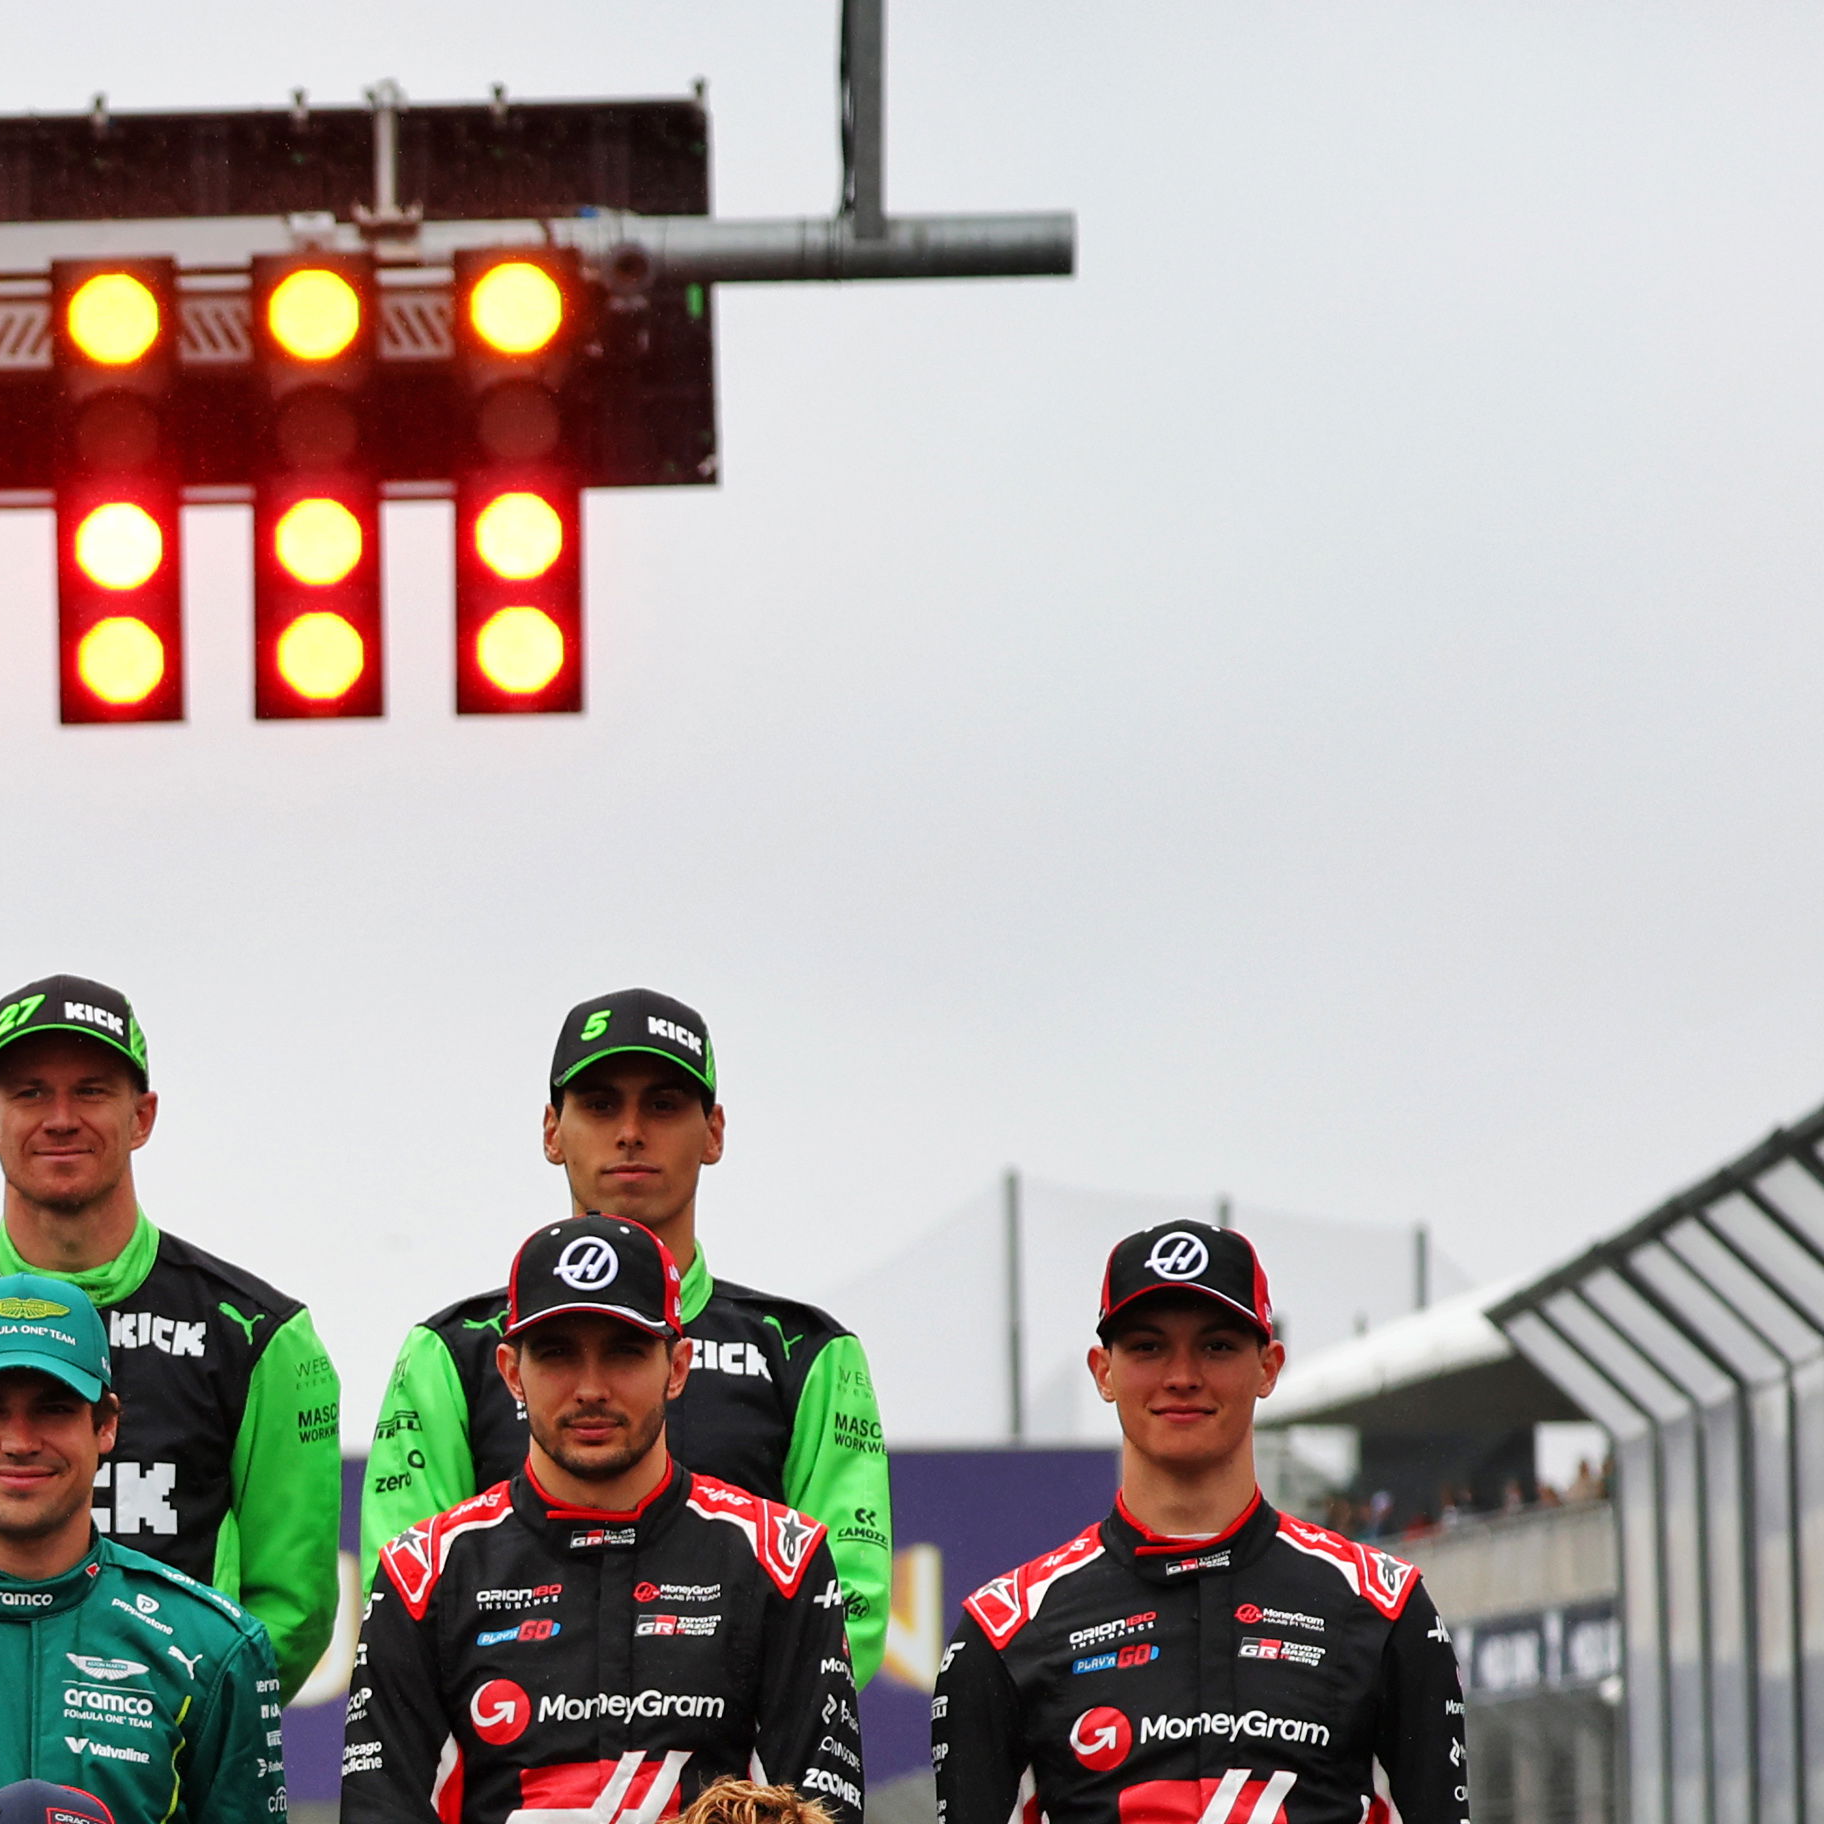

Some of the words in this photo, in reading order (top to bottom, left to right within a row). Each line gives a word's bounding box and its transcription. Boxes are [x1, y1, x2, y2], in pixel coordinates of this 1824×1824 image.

[64, 1001, 124, 1037] KICK
[580, 1009, 611, 1042] 5
[648, 1016, 703, 1057] KICK
[50, 1330, 76, 1346] TEAM
[109, 1310, 207, 1358] KICK
[376, 1471, 412, 1494] zero
[478, 1595, 559, 1611] INSURANCE
[660, 1584, 720, 1595] MoneyGram
[111, 1596, 174, 1636] pepperstone
[1263, 1608, 1324, 1625] MoneyGram
[1072, 1621, 1155, 1650] INSURANCE
[64, 1689, 153, 1716] aramco
[538, 1690, 725, 1725] MoneyGram
[129, 1718, 152, 1728] TEAM
[1140, 1709, 1330, 1748] MoneyGram
[89, 1742, 150, 1764] Valvoline
